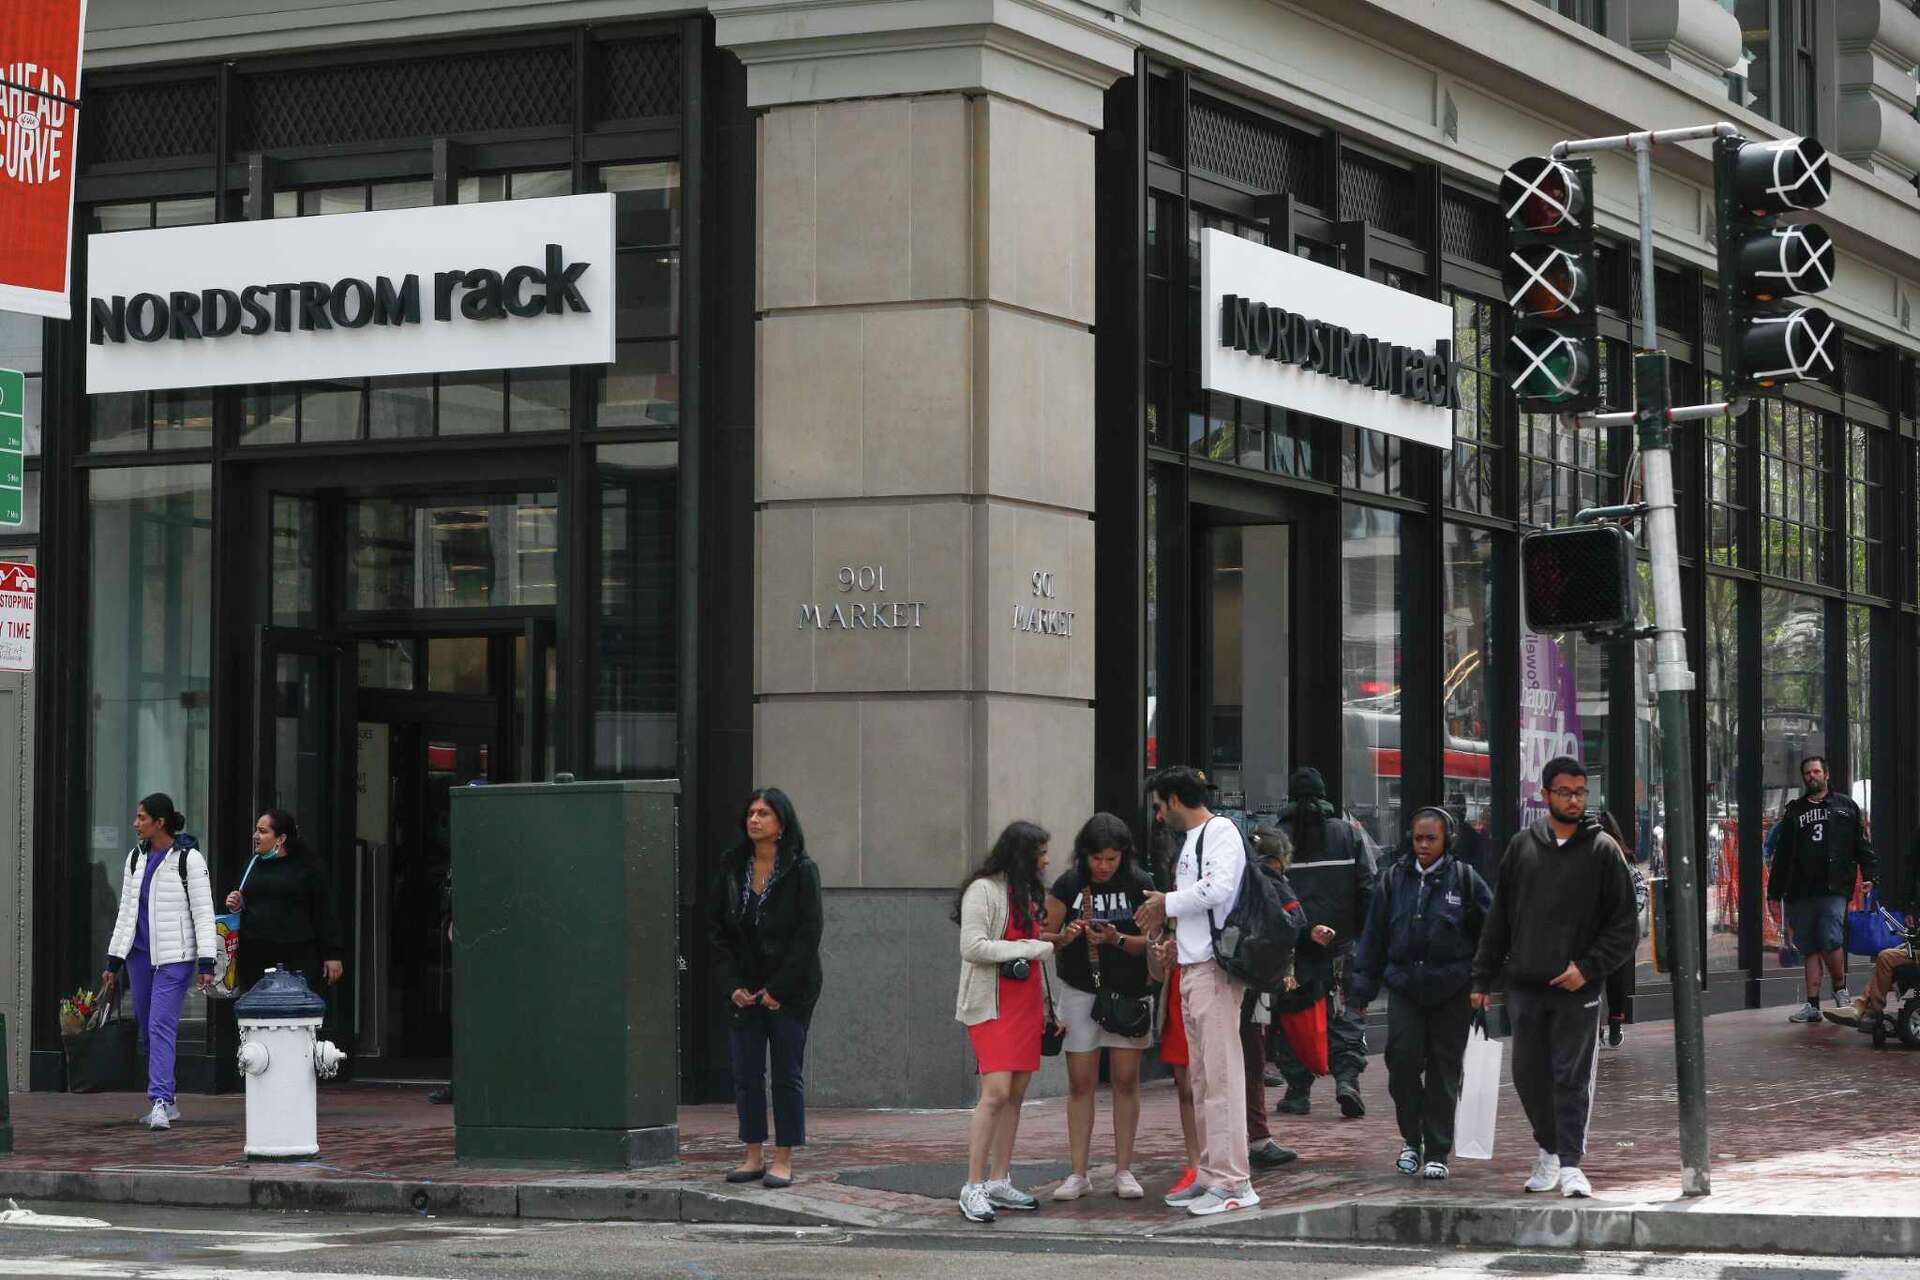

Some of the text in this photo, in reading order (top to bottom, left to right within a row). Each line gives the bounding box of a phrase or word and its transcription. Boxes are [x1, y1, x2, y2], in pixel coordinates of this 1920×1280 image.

[90, 243, 591, 345] NORDSTROM rack
[1221, 294, 1461, 410] NORDSTROM rack
[838, 565, 887, 593] 901
[1032, 568, 1055, 599] 901
[0, 594, 33, 610] STOPPING
[799, 602, 927, 630] MARKET
[7, 622, 31, 639] TIME
[1011, 603, 1075, 638] MARKET
[1812, 823, 1823, 841] 3
